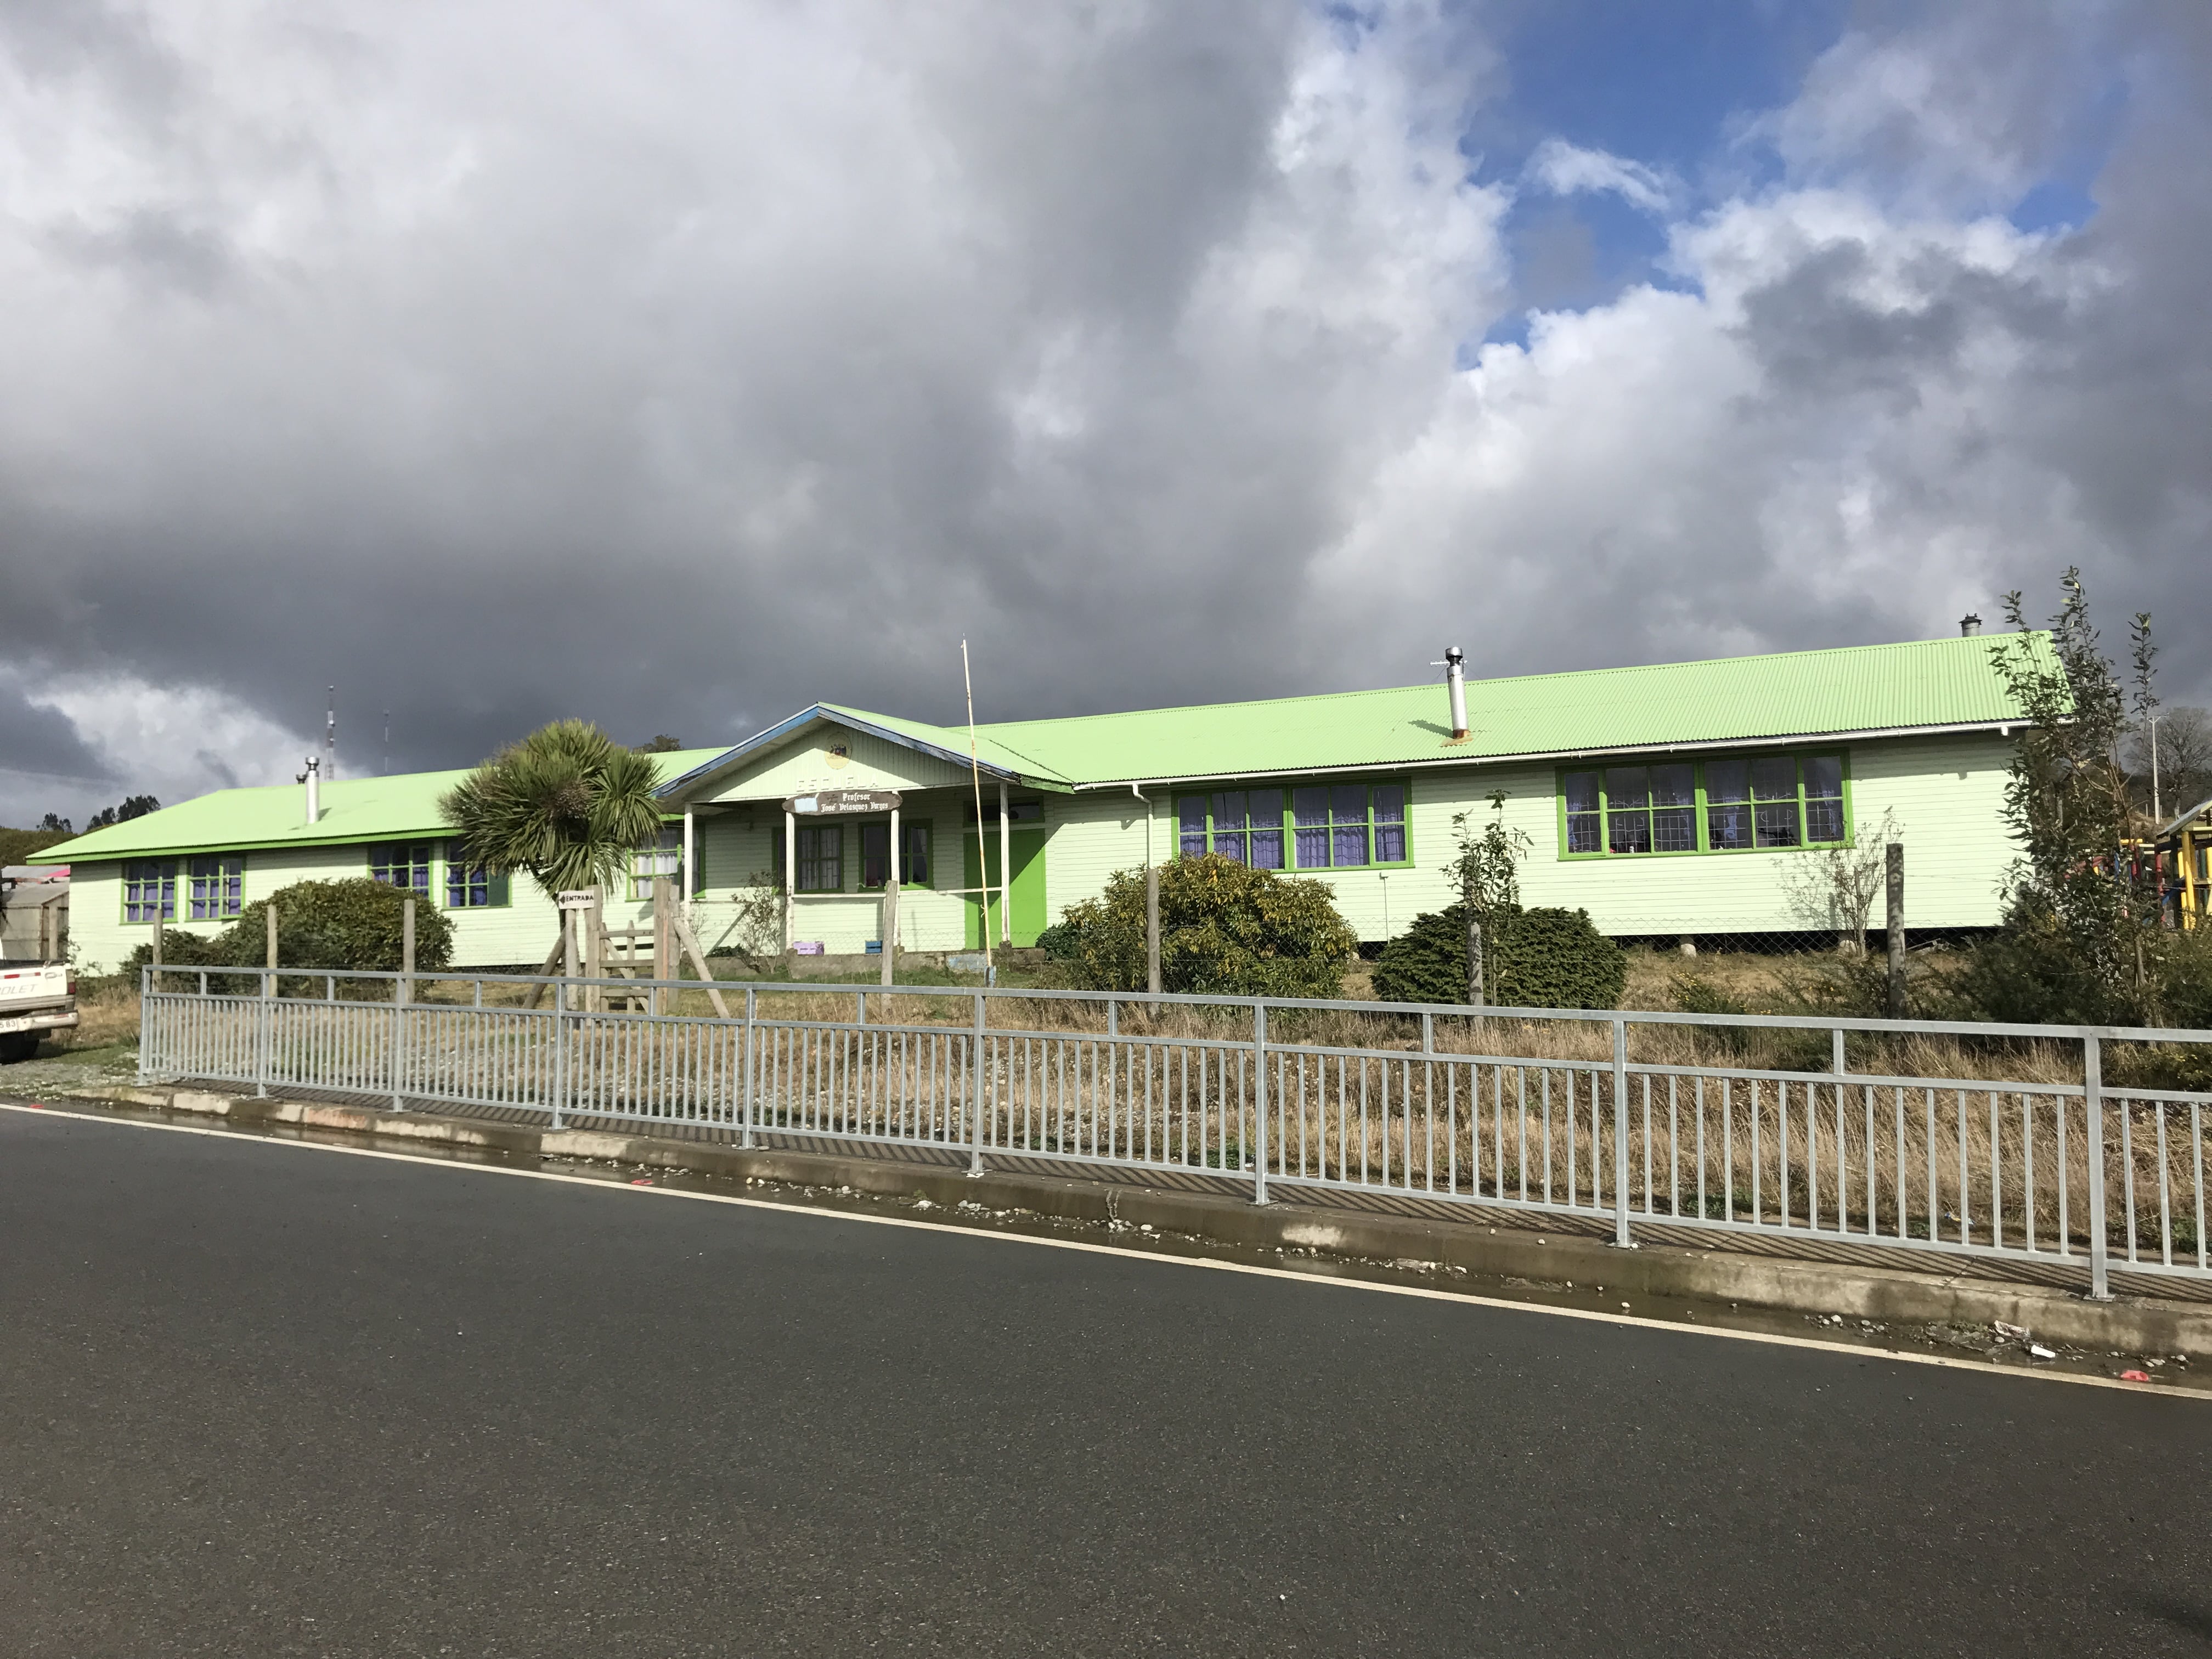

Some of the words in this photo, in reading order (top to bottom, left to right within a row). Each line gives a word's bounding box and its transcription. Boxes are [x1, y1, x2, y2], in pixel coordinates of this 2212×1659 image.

[797, 774, 879, 792] ESCUELA
[842, 792, 871, 802] Profesor
[821, 803, 837, 813] José
[0, 984, 38, 995] OLET
